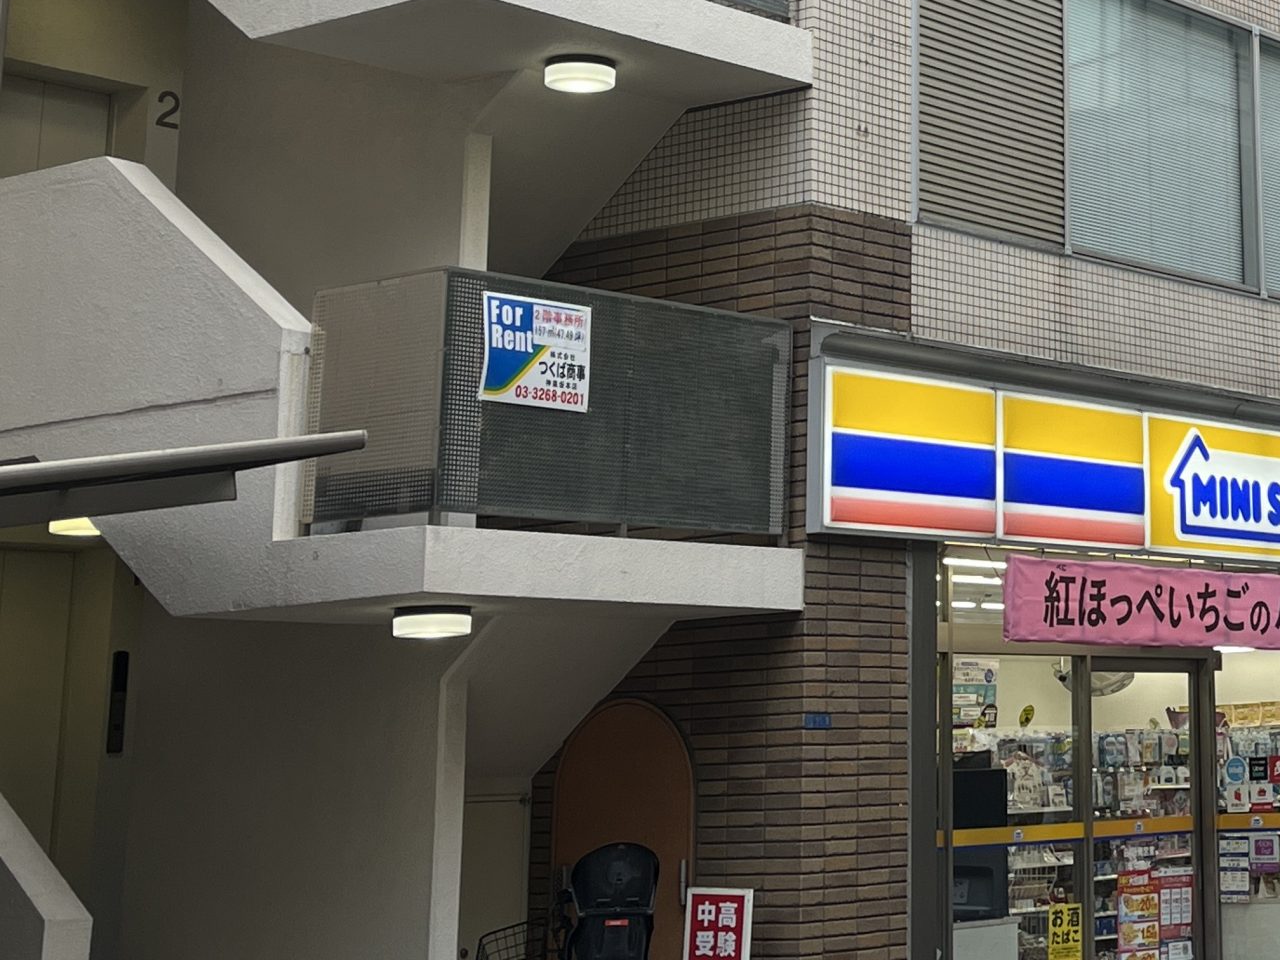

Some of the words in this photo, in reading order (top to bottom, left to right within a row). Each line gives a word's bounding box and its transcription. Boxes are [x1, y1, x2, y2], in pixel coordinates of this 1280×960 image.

[156, 91, 180, 129] 2
[491, 300, 523, 326] For
[491, 324, 534, 353] Rent
[539, 361, 586, 381] つくば商事
[515, 385, 584, 405] 03-3268-0201
[1192, 472, 1261, 524] MINI
[697, 901, 738, 928] 中高
[1052, 907, 1080, 928] お酒
[695, 930, 737, 957] 受験
[1051, 929, 1080, 945] たばこ
